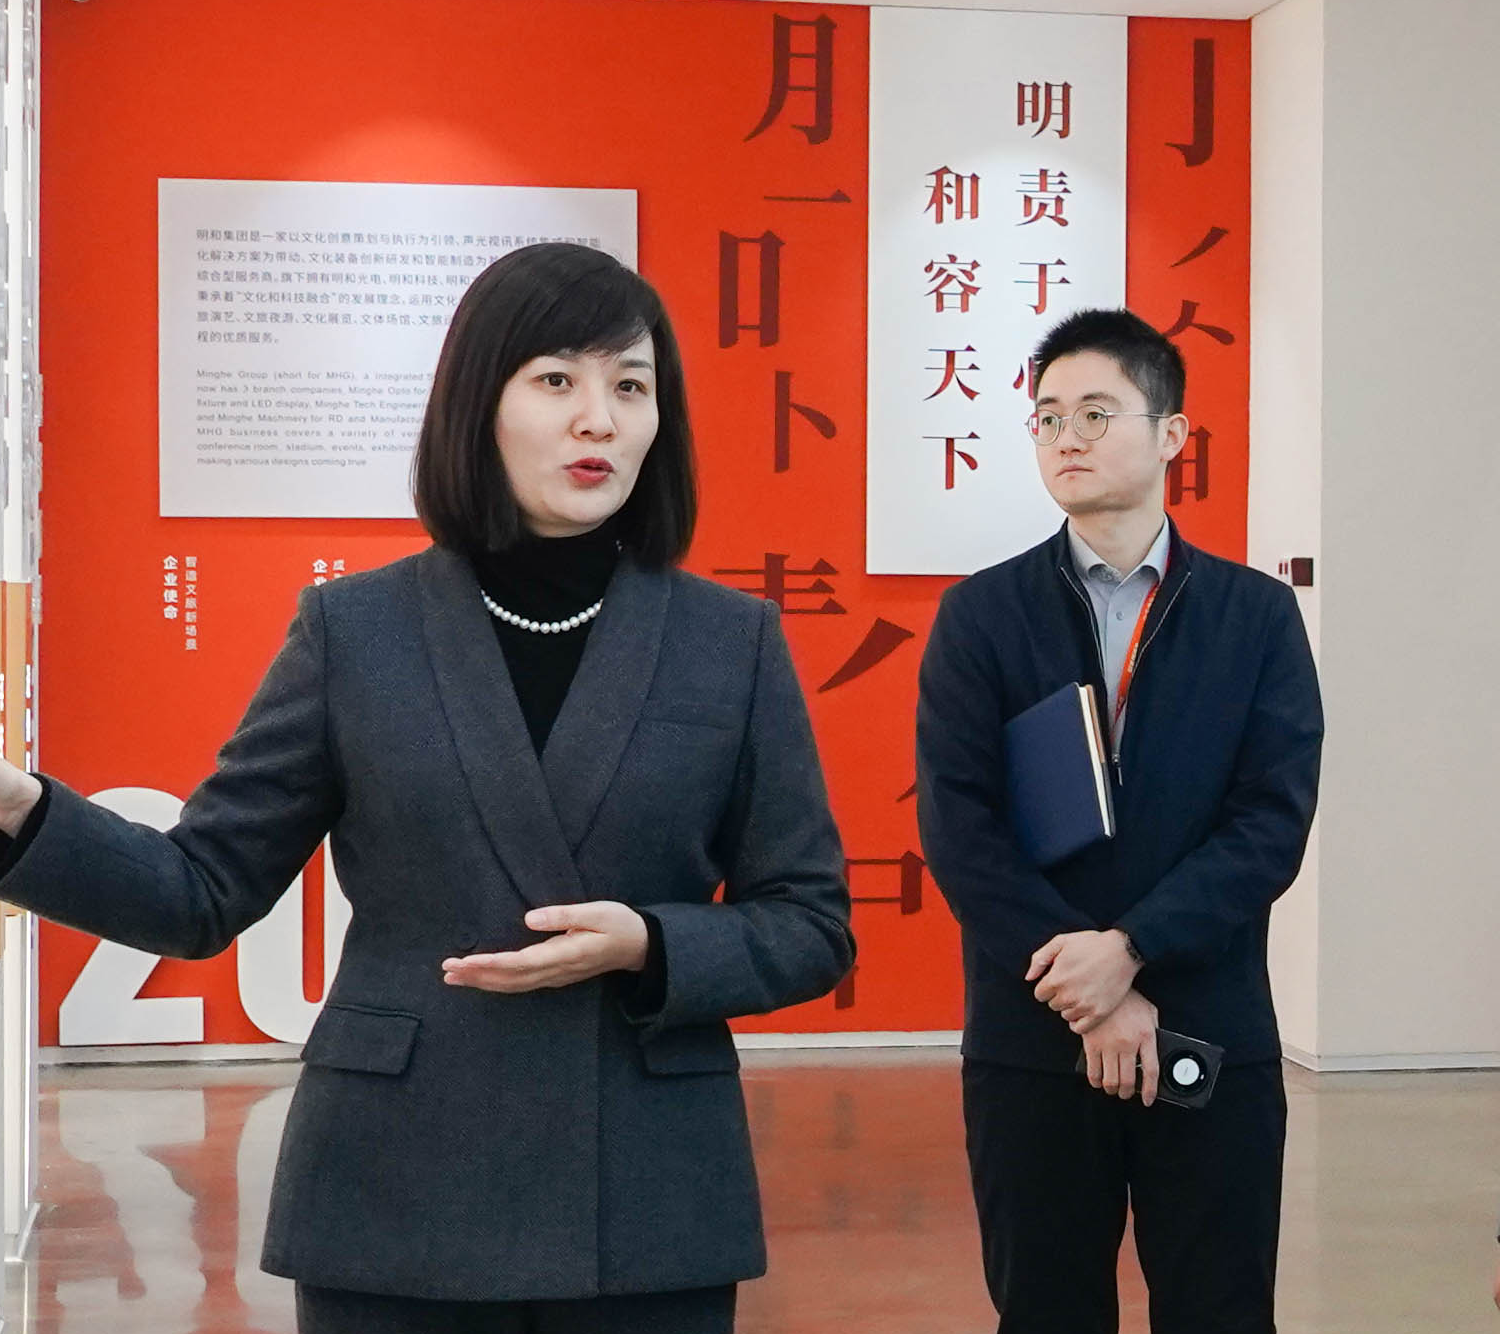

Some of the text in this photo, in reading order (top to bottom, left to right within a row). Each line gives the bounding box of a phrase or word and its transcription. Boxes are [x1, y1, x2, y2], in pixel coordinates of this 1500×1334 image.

[922, 164, 982, 492] 和容天下
[196, 369, 232, 380] Minghe
[237, 370, 268, 381] Group
[307, 370, 321, 379] for
[220, 385, 238, 393] has
[252, 385, 286, 394] branch
[348, 386, 383, 397] Minghe
[230, 399, 248, 408] and
[252, 399, 272, 408] LED
[315, 400, 349, 411] Minghe
[354, 400, 377, 409] Tech
[196, 414, 215, 422] and
[218, 414, 253, 425] Minghe
[311, 414, 324, 423] for
[348, 415, 366, 423] and
[196, 428, 223, 436] MHG
[230, 429, 279, 437] business
[341, 429, 377, 440] variety
[383, 430, 395, 438] of
[162, 554, 180, 620] 企业使命
